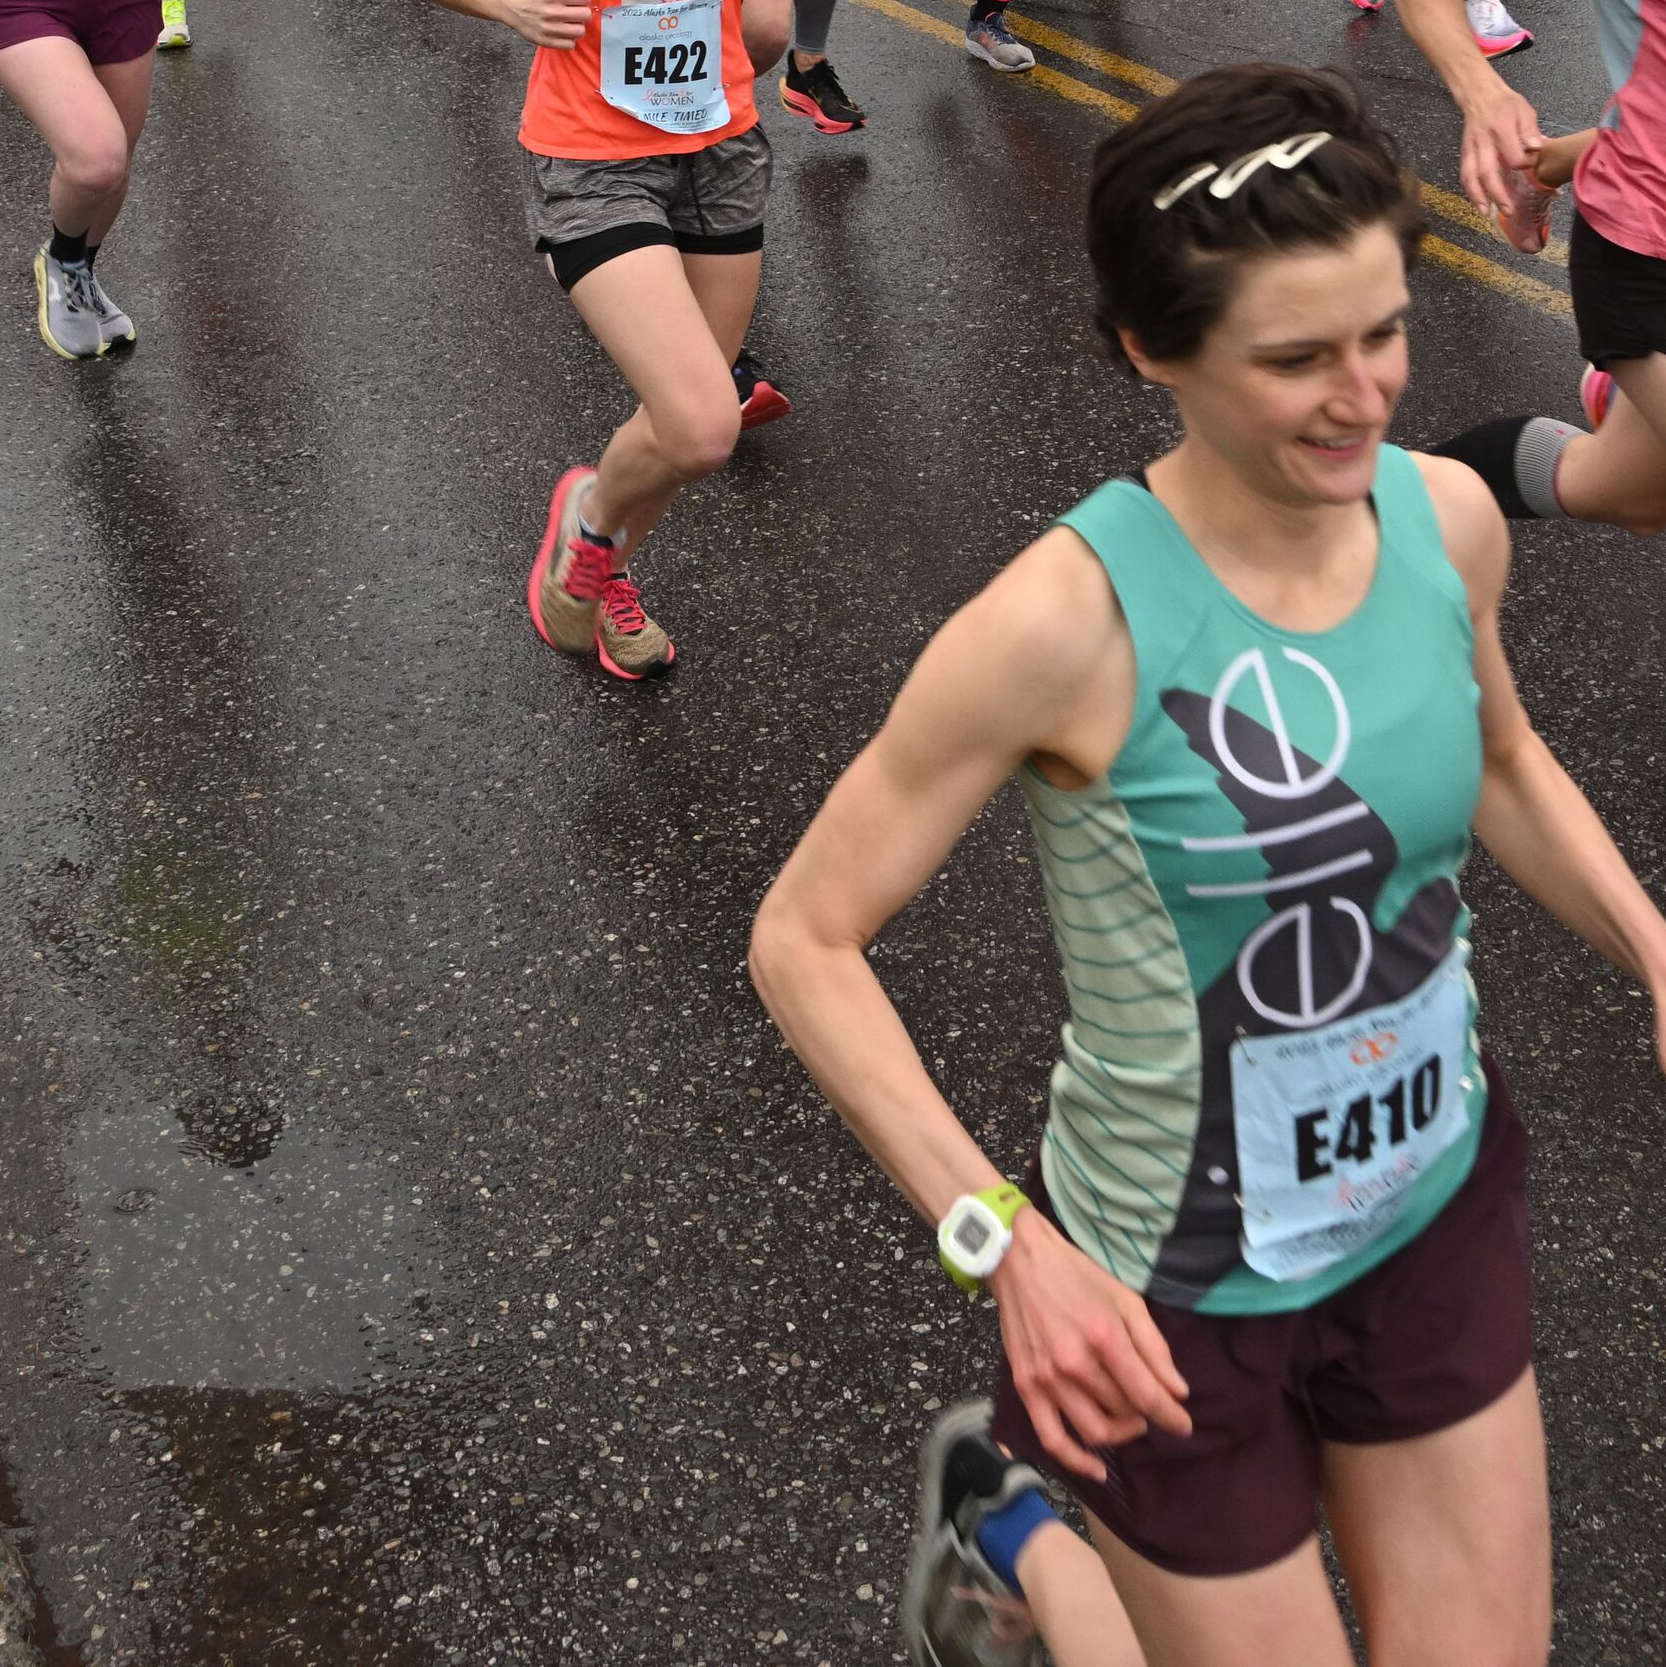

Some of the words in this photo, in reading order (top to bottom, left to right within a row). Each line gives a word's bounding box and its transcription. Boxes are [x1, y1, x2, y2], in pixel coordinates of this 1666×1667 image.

[622, 8, 643, 17] 2023
[644, 7, 666, 16] Alaska
[667, 6, 679, 15] Run
[679, 5, 688, 14] for
[638, 33, 663, 42] alaska
[664, 30, 694, 41] oncology
[624, 40, 707, 85] E422
[650, 95, 694, 106] WOMEN
[643, 111, 669, 123] MILE
[673, 108, 708, 122] TIMED
[1294, 1052, 1441, 1186] E410
